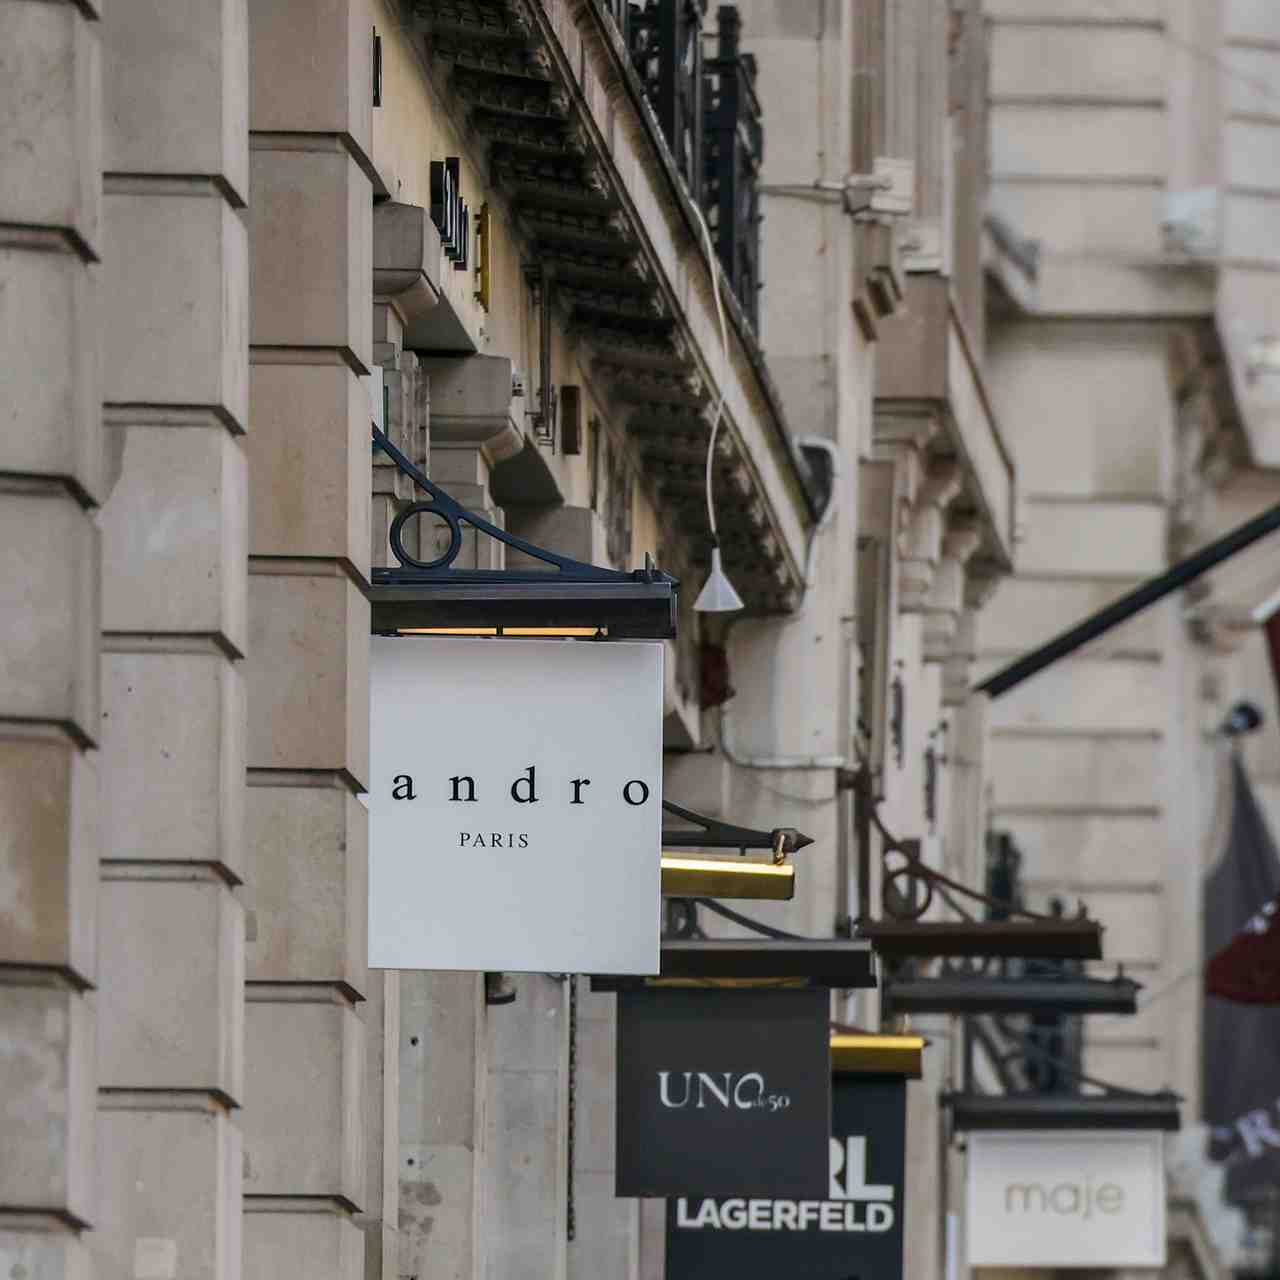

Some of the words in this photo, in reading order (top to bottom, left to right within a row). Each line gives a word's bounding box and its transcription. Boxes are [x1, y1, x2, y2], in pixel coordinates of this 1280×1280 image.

[391, 766, 650, 805] andro
[459, 832, 529, 848] PARIS
[1004, 1172, 1124, 1220] maje
[677, 1198, 895, 1232] LAGERFELD
